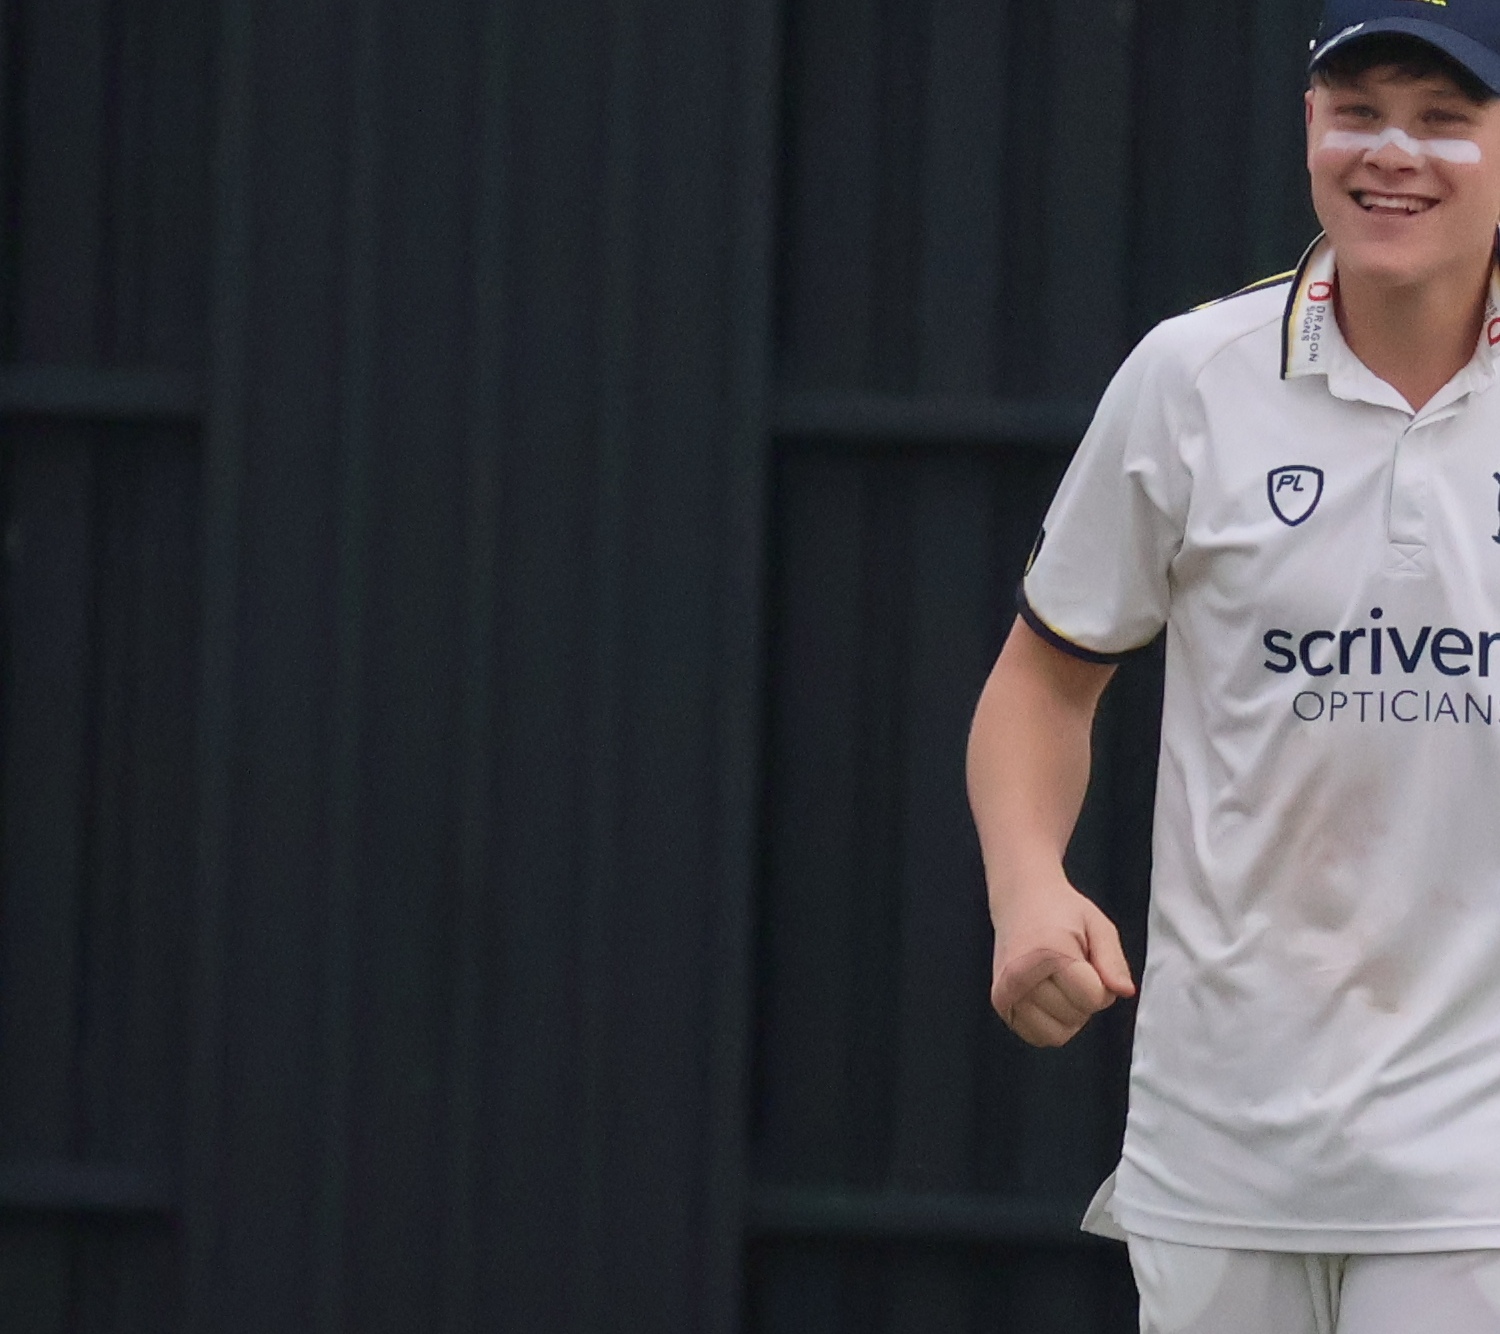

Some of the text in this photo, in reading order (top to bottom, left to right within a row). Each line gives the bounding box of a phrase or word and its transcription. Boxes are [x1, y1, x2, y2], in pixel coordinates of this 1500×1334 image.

[1301, 305, 1316, 342] SIGNS
[1308, 305, 1326, 363] DRAGON
[1275, 473, 1304, 493] PL
